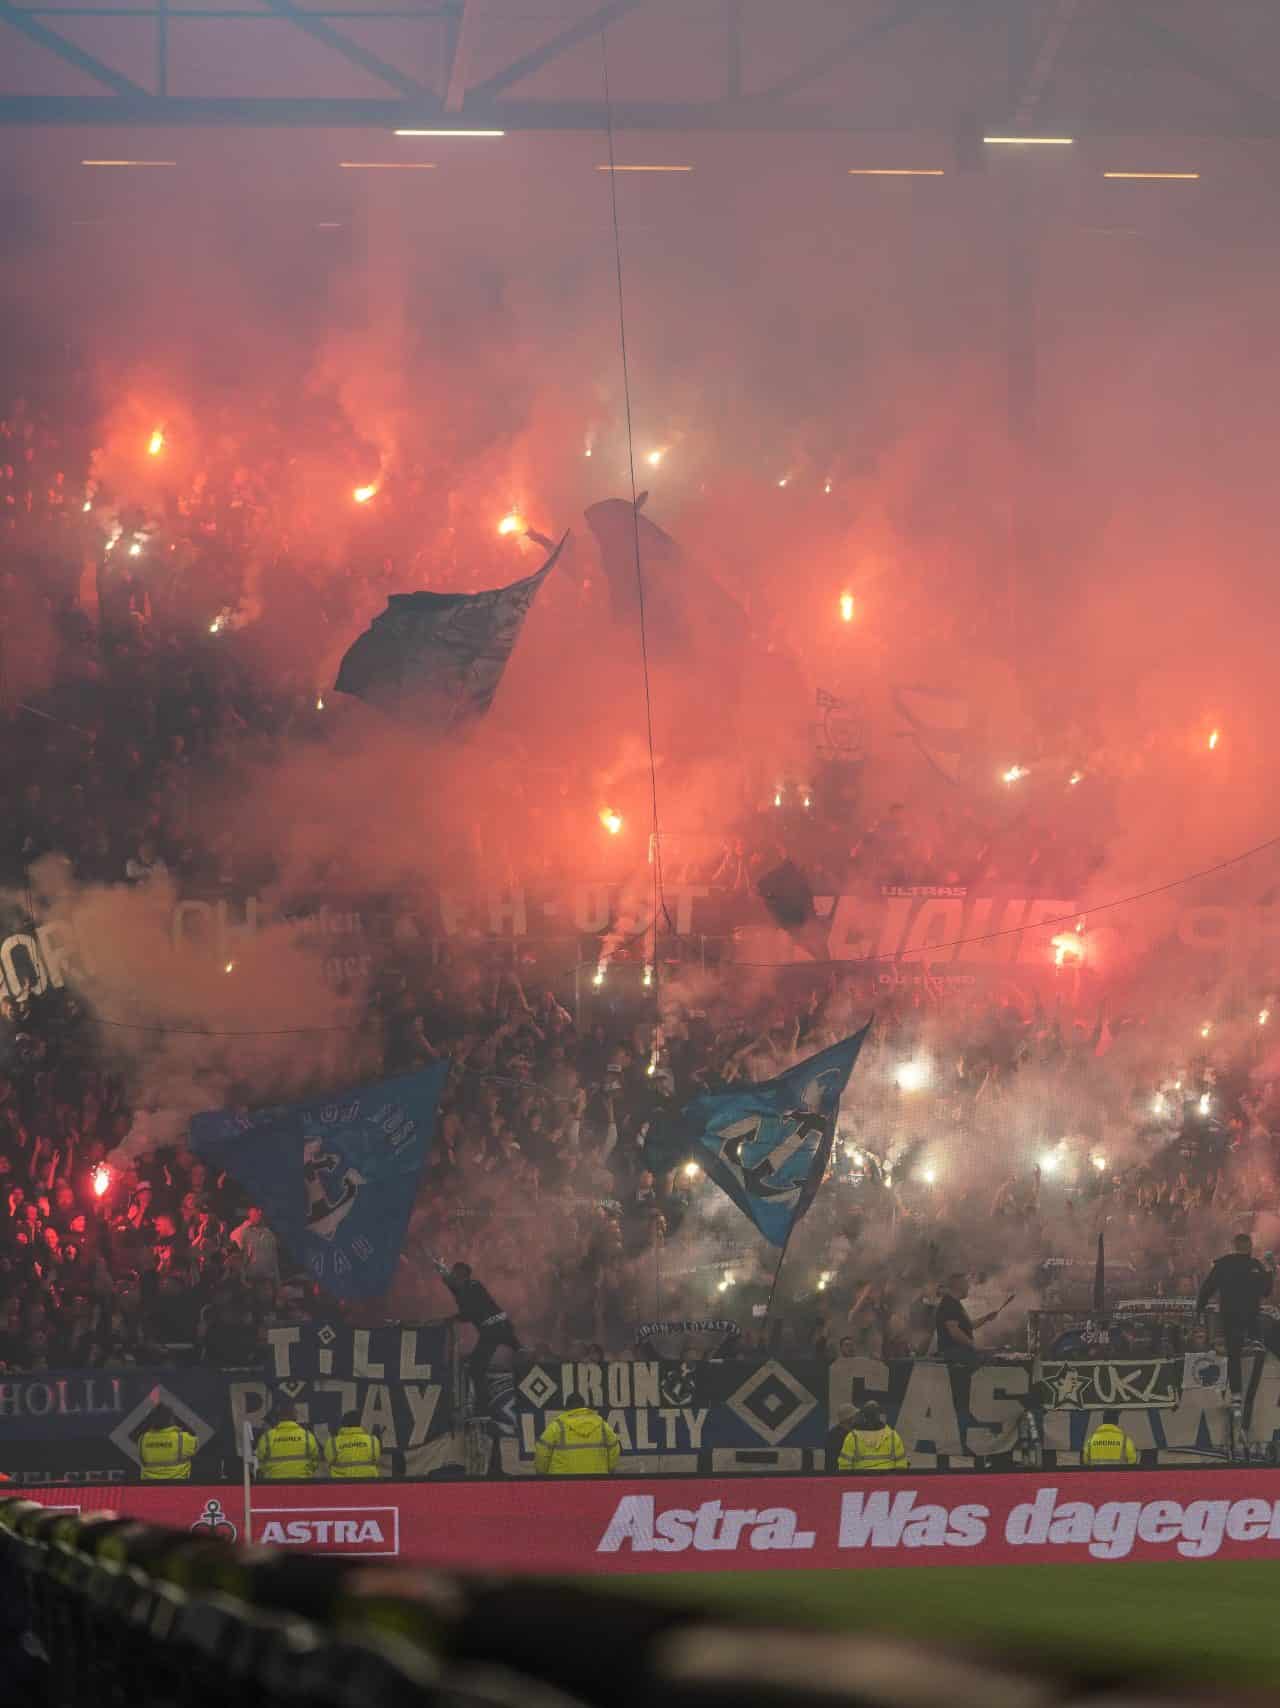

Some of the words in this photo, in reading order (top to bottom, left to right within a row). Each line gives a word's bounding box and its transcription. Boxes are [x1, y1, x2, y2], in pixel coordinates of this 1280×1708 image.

[561, 1361, 661, 1408] IRON
[521, 1408, 710, 1453] LALTY
[260, 1518, 386, 1545] ASTRA
[596, 1495, 816, 1552] Astra.
[838, 1490, 990, 1548] Was
